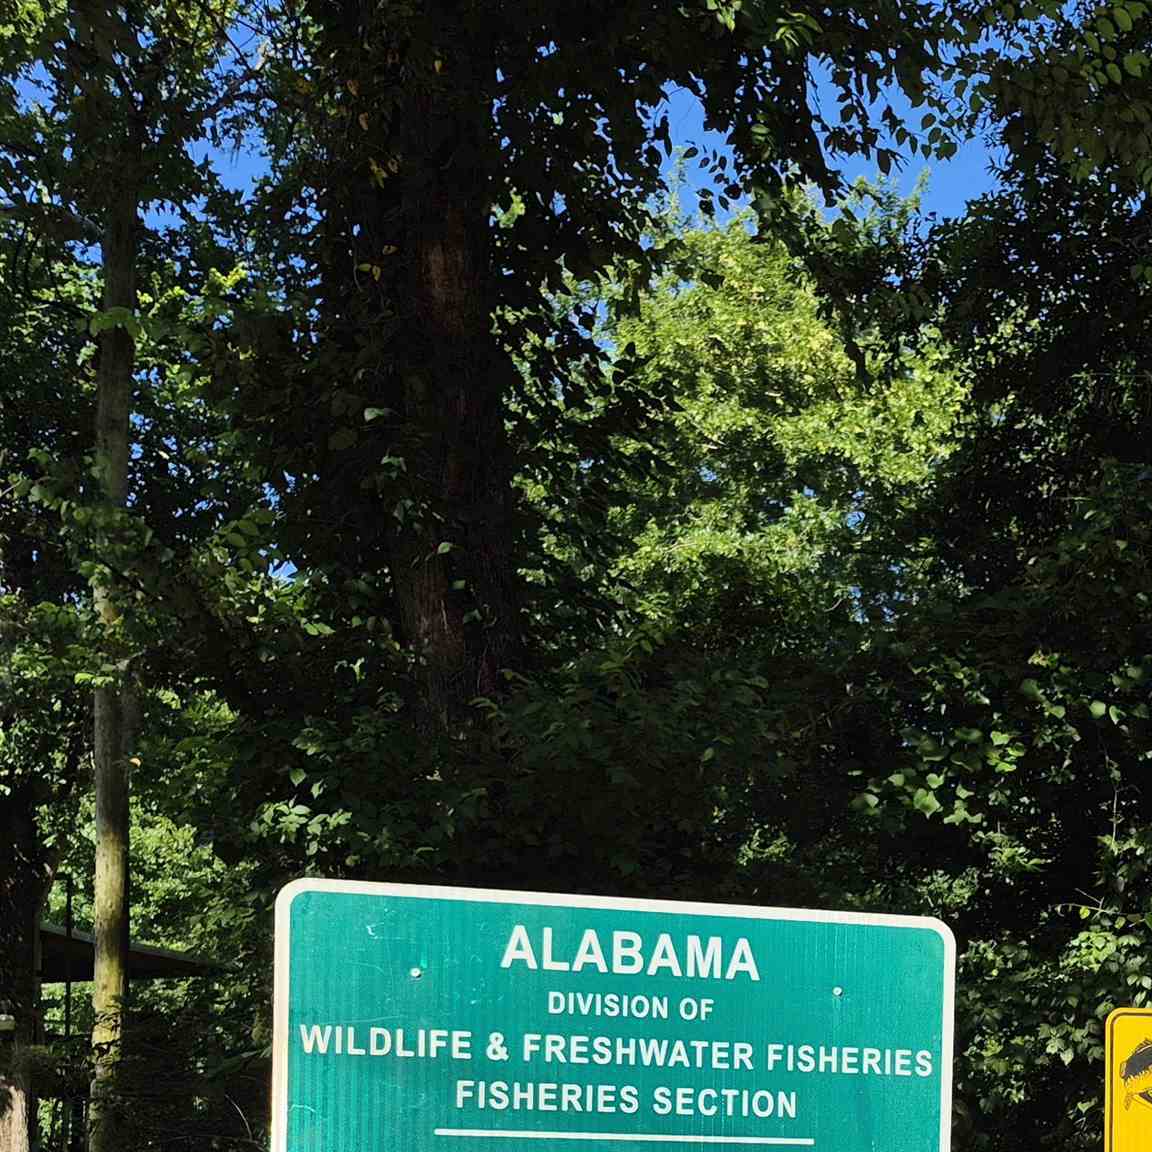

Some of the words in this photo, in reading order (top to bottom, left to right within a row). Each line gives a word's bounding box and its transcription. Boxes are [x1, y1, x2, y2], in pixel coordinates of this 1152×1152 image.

[501, 925, 760, 981] ALABAMA
[547, 990, 669, 1019] DIVISION
[680, 994, 714, 1021] OF
[300, 1024, 473, 1060] WILDLIFE
[486, 1031, 510, 1062] &
[523, 1033, 754, 1071] FRESHWATER
[768, 1043, 934, 1077] FISHERIES
[456, 1079, 640, 1114] FISHERIES
[652, 1085, 798, 1118] SECTION
